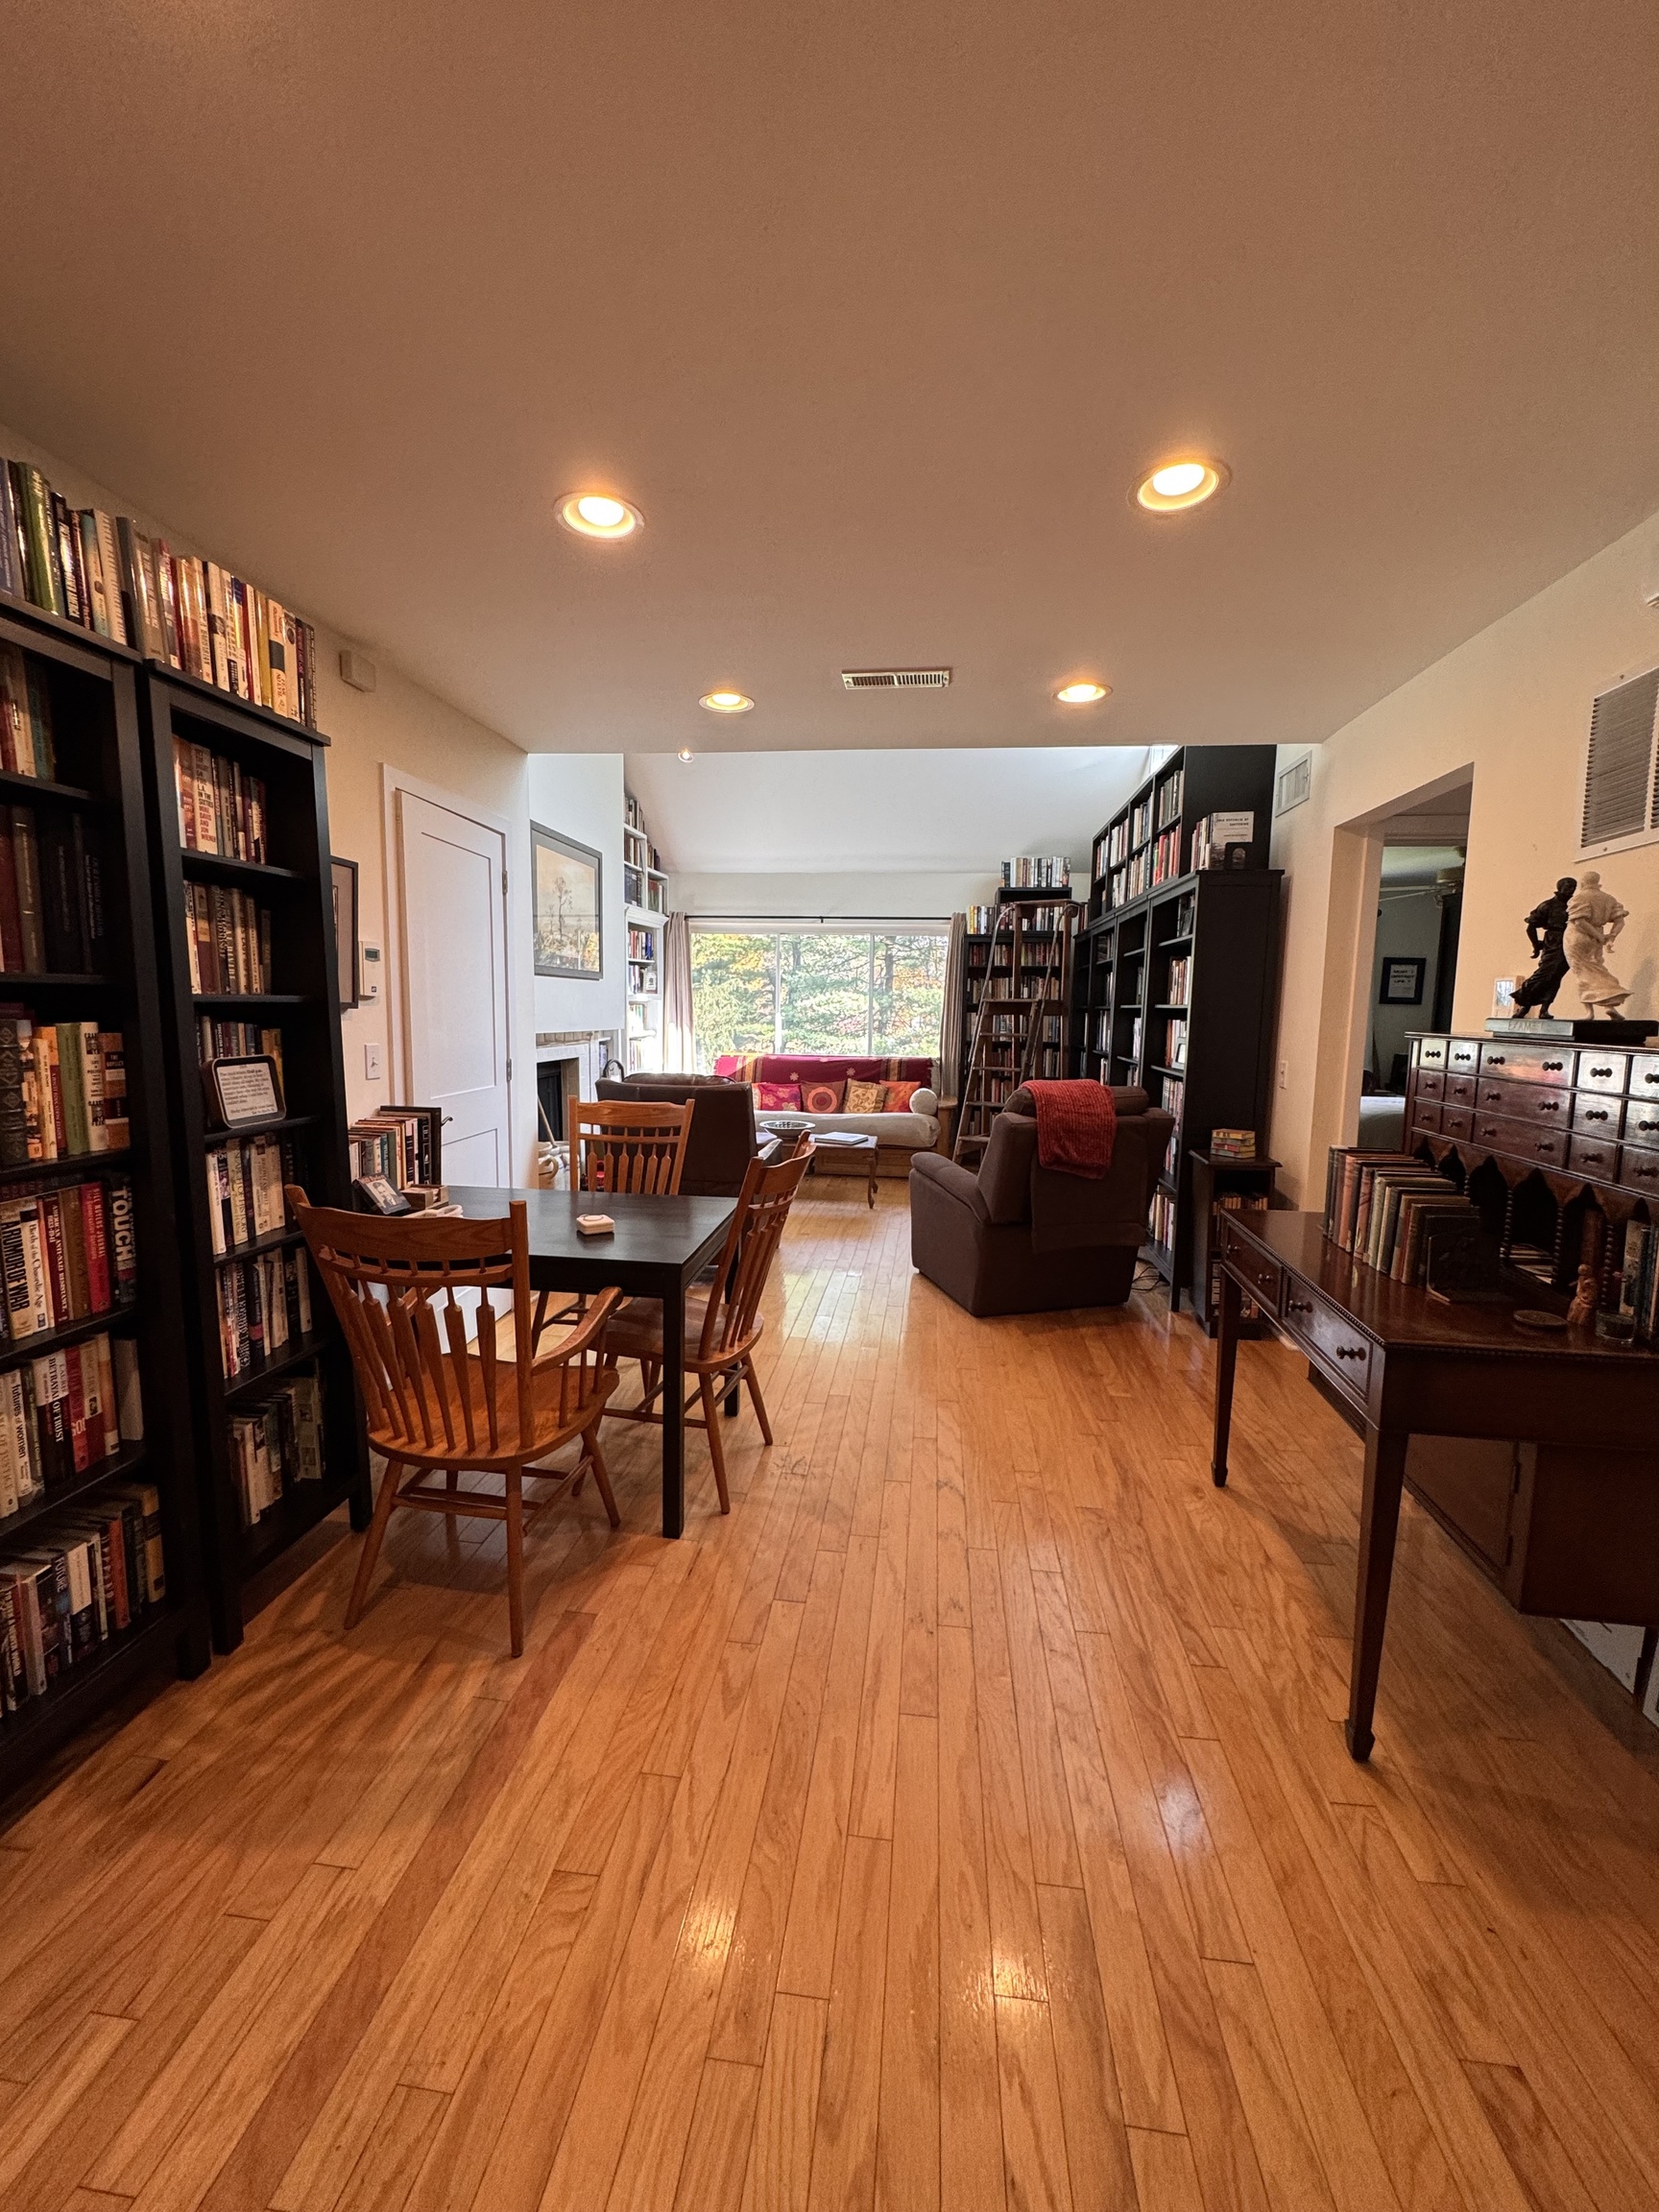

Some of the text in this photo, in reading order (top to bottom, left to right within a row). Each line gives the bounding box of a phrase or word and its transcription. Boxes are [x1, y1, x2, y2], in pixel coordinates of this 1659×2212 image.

[199, 799, 213, 808] SIXTIES
[52, 1205, 60, 1237] AMERICAN
[56, 1239, 64, 1272] ANTI-NAZI
[112, 1189, 134, 1261] TOUCH
[2, 1228, 25, 1271] RUMOR
[7, 1269, 27, 1284] OF
[9, 1283, 29, 1312] WAR
[35, 1294, 43, 1309] Age
[49, 1358, 60, 1400] BETRAYAL
[12, 1384, 22, 1416] futures
[16, 1423, 26, 1458] women
[54, 1414, 64, 1443] TRUST
[55, 1556, 68, 1593] FUTURE
